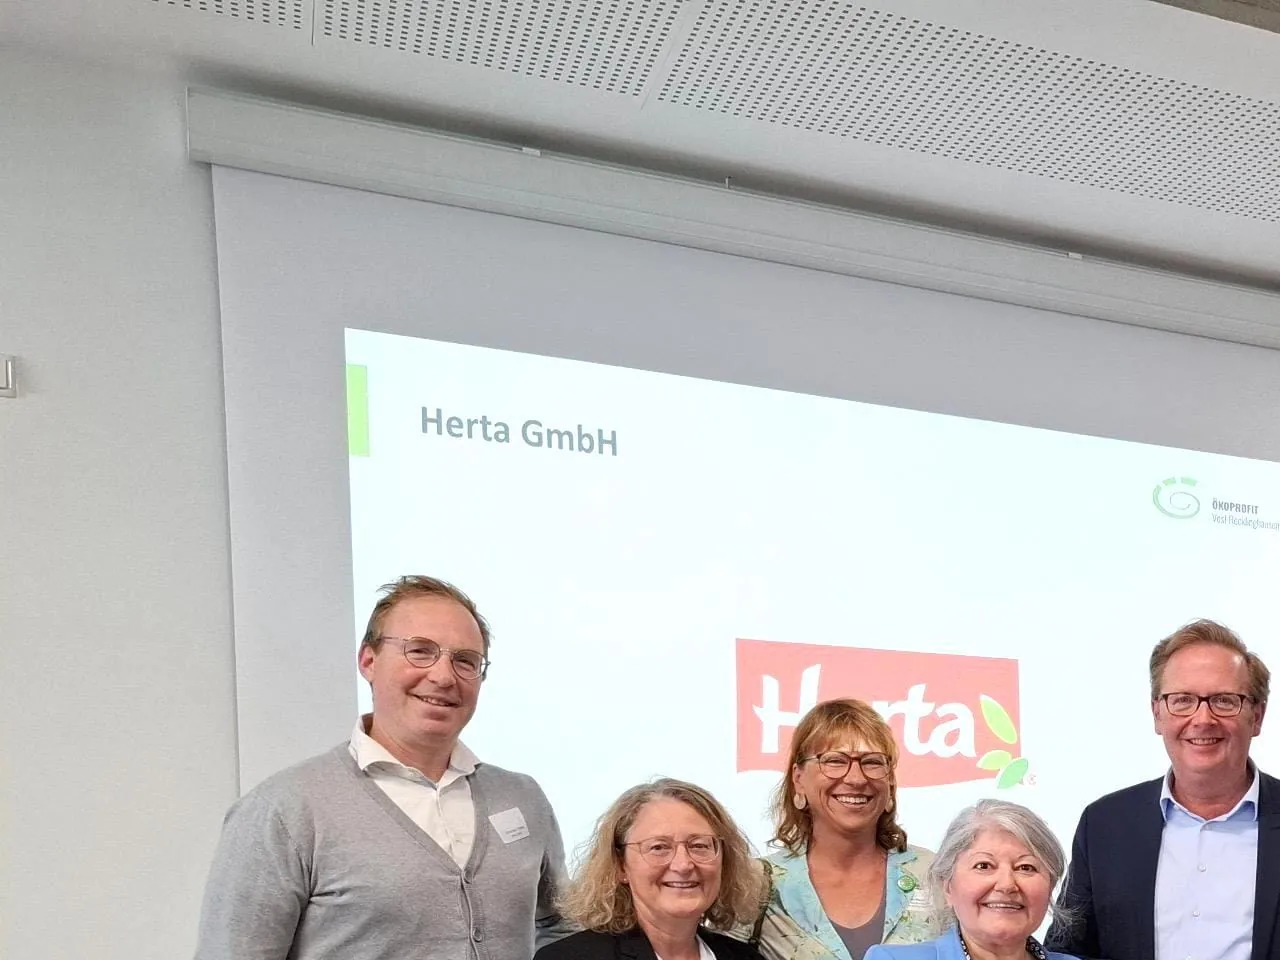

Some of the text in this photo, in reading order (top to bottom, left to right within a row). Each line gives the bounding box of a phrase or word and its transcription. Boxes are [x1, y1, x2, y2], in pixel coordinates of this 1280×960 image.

[421, 406, 617, 456] Herta GmbH
[1211, 497, 1259, 515] ÖKOPROFIT
[752, 663, 977, 757] Hrta
